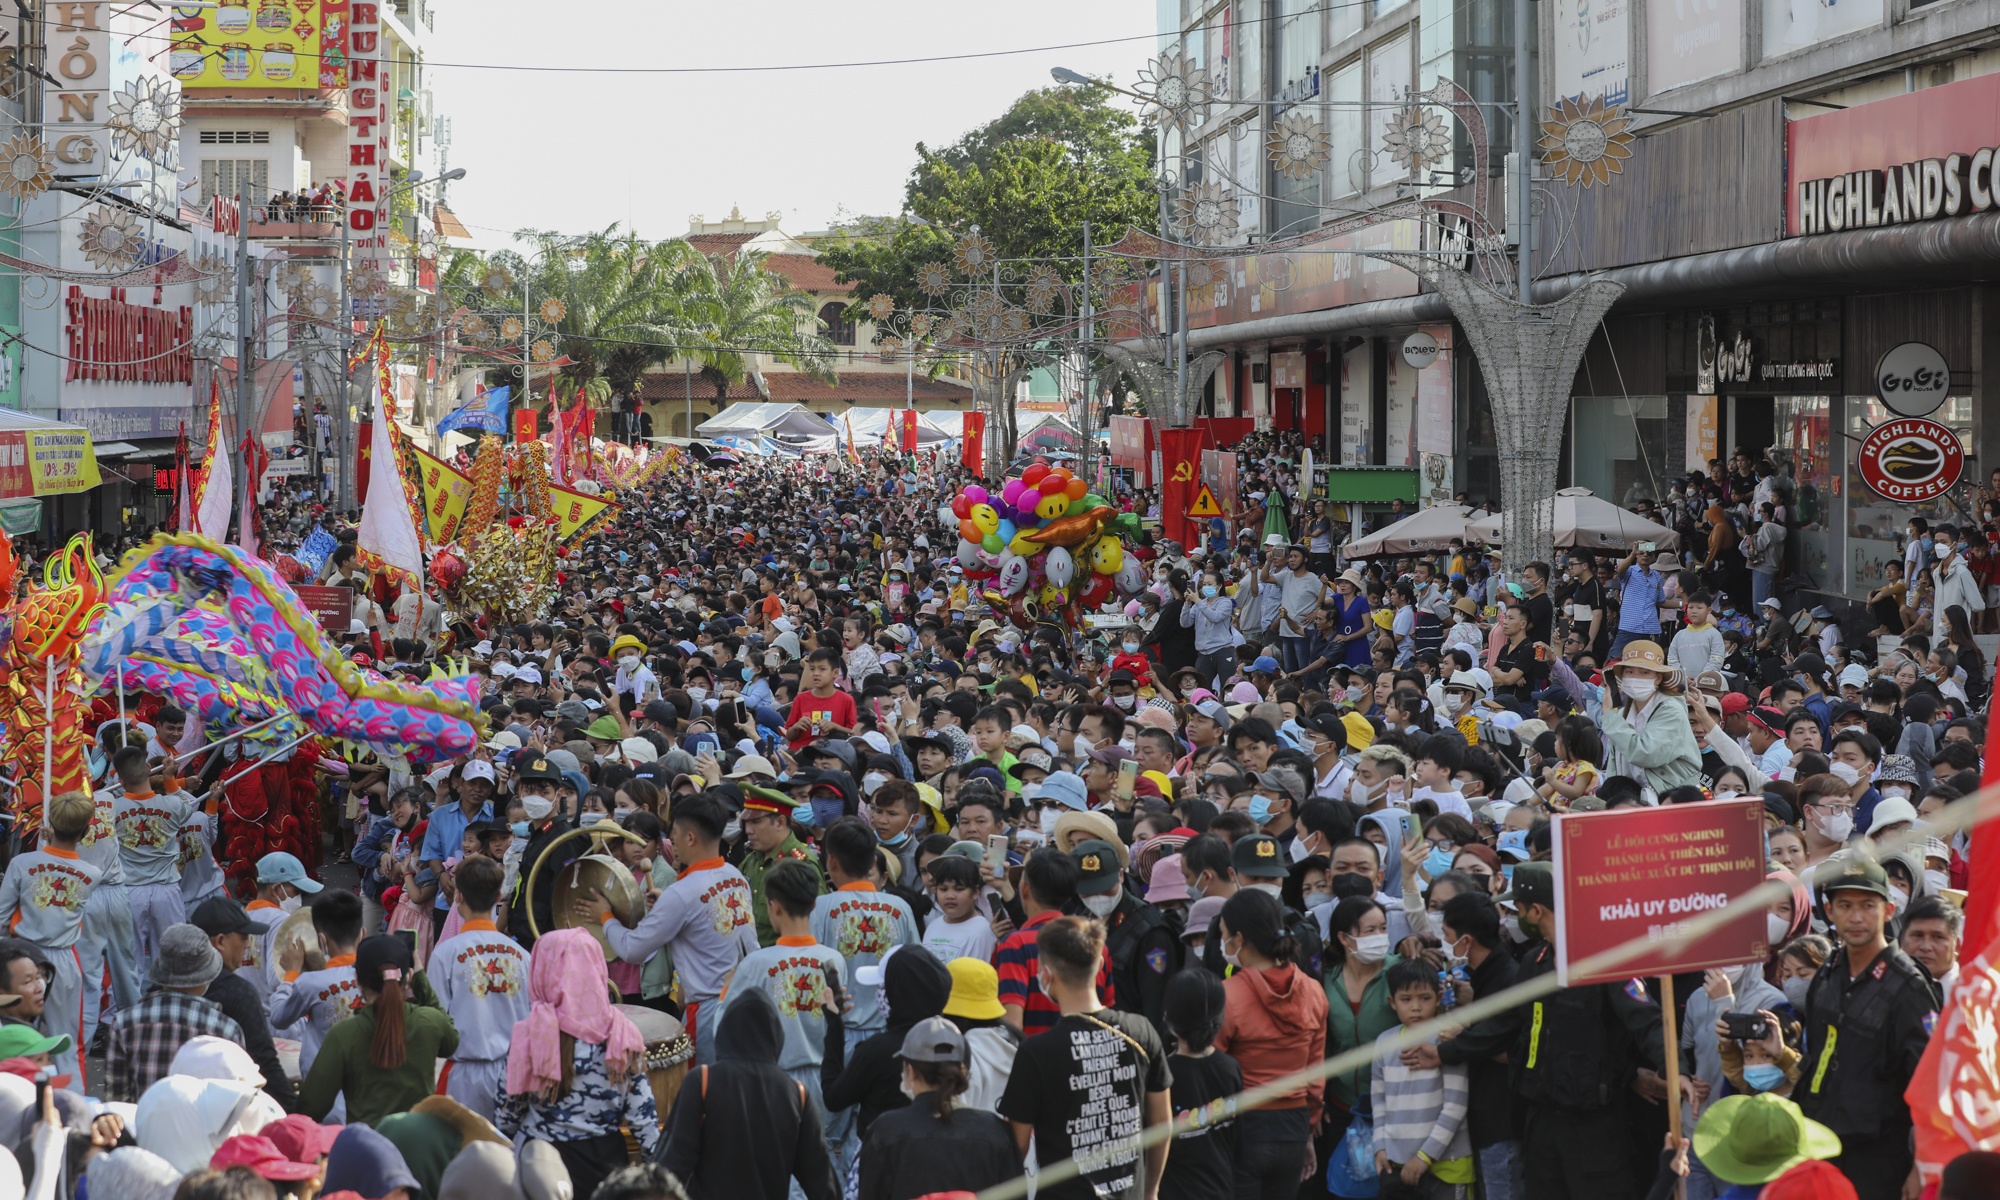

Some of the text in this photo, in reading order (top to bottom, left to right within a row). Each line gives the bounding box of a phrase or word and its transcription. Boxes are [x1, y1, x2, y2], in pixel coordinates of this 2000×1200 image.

[1799, 152, 1962, 236] HIGHLANDS
[1864, 423, 1958, 457] HIGHLANDS
[1877, 476, 1949, 497] COFFEE
[1607, 827, 1724, 849] LỄ HỘI CUNG NGHINH
[1604, 843, 1729, 867] THÁNH GIÁ THIÊN HẬU
[1577, 872, 1617, 887] THÁNH
[1647, 862, 1677, 879] XUẤT
[1680, 865, 1696, 877] DU
[1698, 861, 1733, 875] THỊNH
[1735, 858, 1755, 870] HỘI
[1600, 891, 1728, 921] KHẢI UY ĐƯỜNG
[1070, 1030, 1091, 1046] CAR
[1112, 1063, 1136, 1082] MON
[1081, 1094, 1130, 1118] PARCE QUE
[1098, 1112, 1110, 1128] LE
[1111, 1118, 1140, 1139] PARCE
